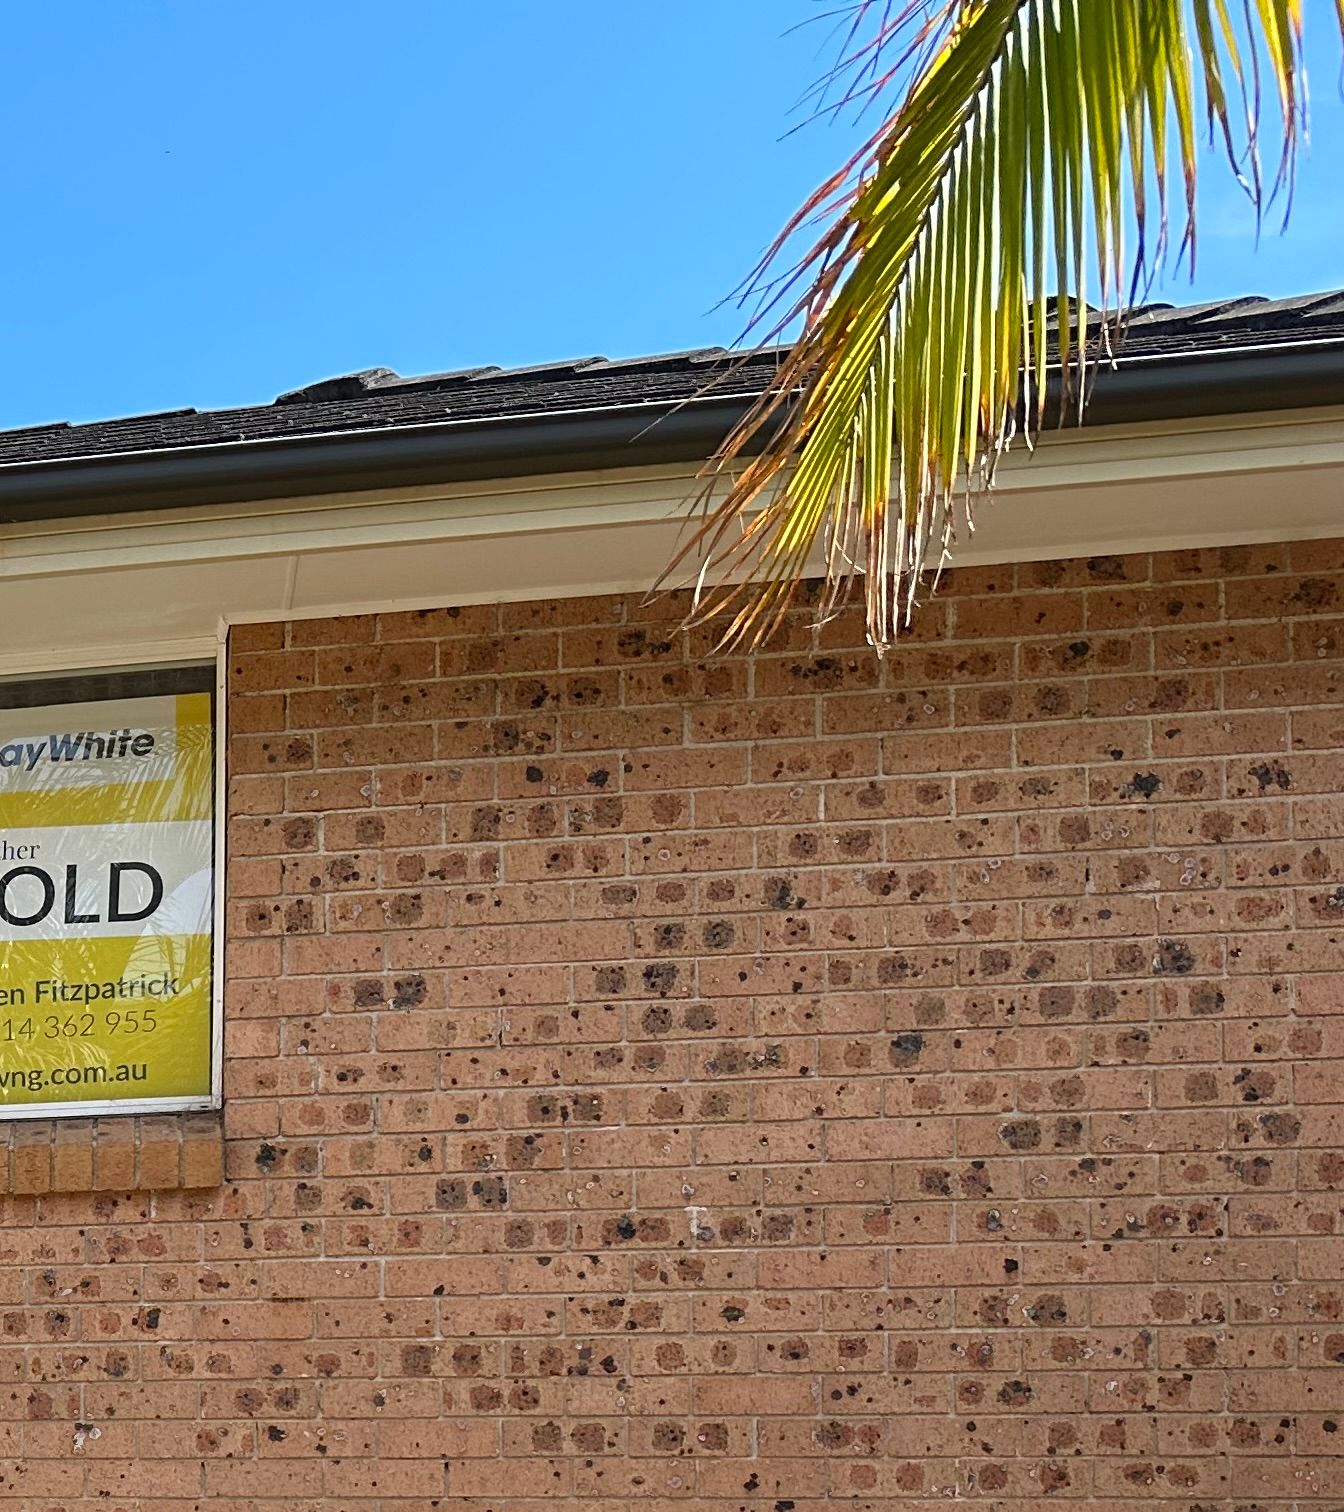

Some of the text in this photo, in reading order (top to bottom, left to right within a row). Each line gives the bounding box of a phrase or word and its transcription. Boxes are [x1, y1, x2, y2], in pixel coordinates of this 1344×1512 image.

[35, 972, 180, 1007] Fitzpatrick
[44, 1013, 95, 1038] 362
[105, 1009, 157, 1035] 955
